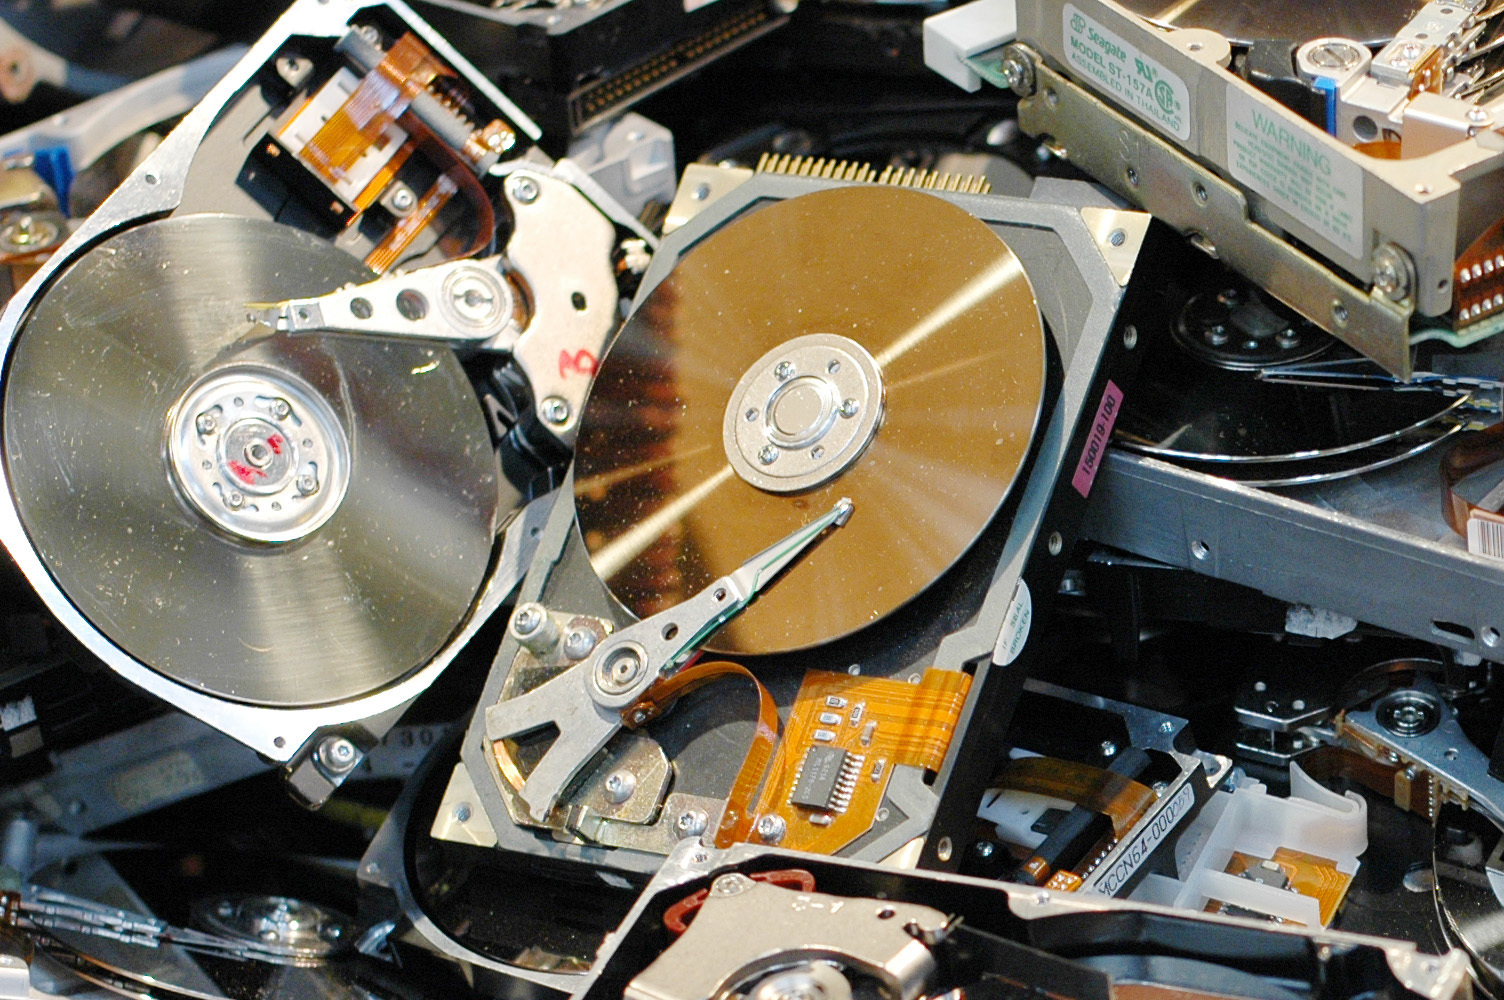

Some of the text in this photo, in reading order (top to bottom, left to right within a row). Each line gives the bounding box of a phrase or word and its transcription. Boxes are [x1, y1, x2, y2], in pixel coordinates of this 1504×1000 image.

[1070, 35, 1154, 101] MODEL ST-157A
[1087, 27, 1127, 63] Seagate
[1072, 52, 1181, 132] ASSEMBLED IN THAILAND
[1252, 109, 1331, 176] WARNING
[1082, 394, 1116, 475] 150019-100
